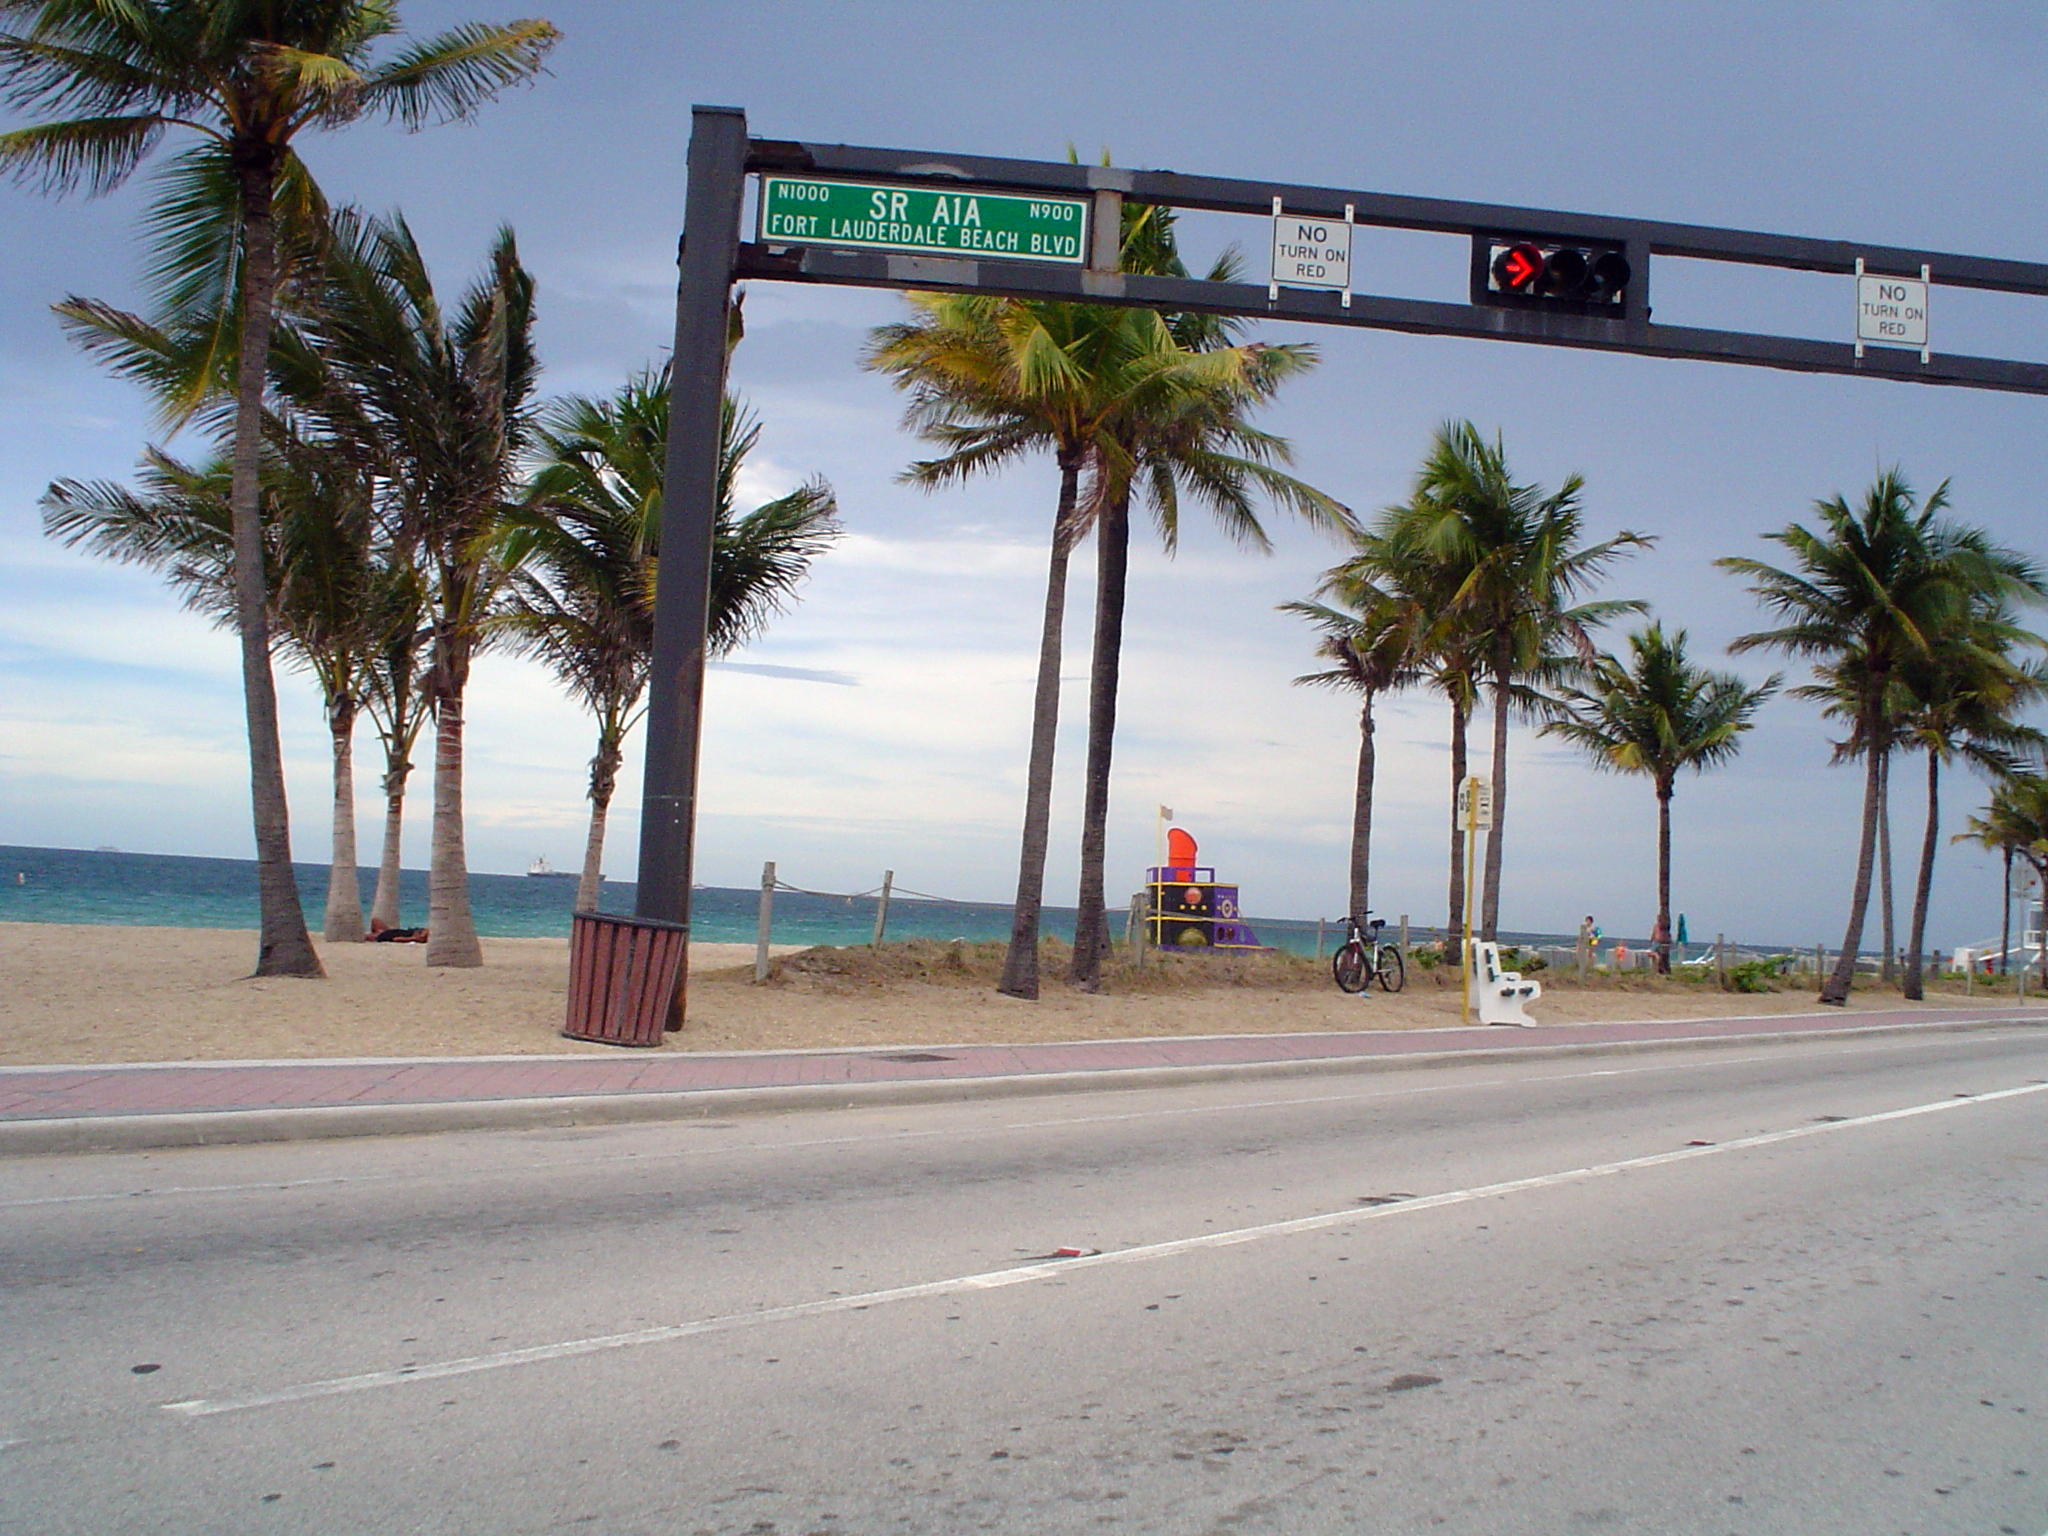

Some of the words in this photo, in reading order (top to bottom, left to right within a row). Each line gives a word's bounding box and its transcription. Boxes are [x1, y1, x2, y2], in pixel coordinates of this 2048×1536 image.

[778, 183, 830, 202] N1000
[869, 190, 909, 221] SR
[931, 195, 981, 228] A1A
[1029, 203, 1074, 221] N900
[771, 214, 819, 236] FORT
[831, 218, 948, 245] LAUDERDALE
[960, 228, 1019, 252] BEACH
[1031, 233, 1076, 256] BLVD
[1298, 225, 1328, 243] NO
[1279, 244, 1318, 260] TURN
[1325, 248, 1346, 262] ON
[1296, 263, 1326, 278] RED
[1879, 284, 1906, 302] NO
[1862, 302, 1899, 318] TURN
[1904, 307, 1924, 321] ON
[1879, 321, 1906, 336] RED
